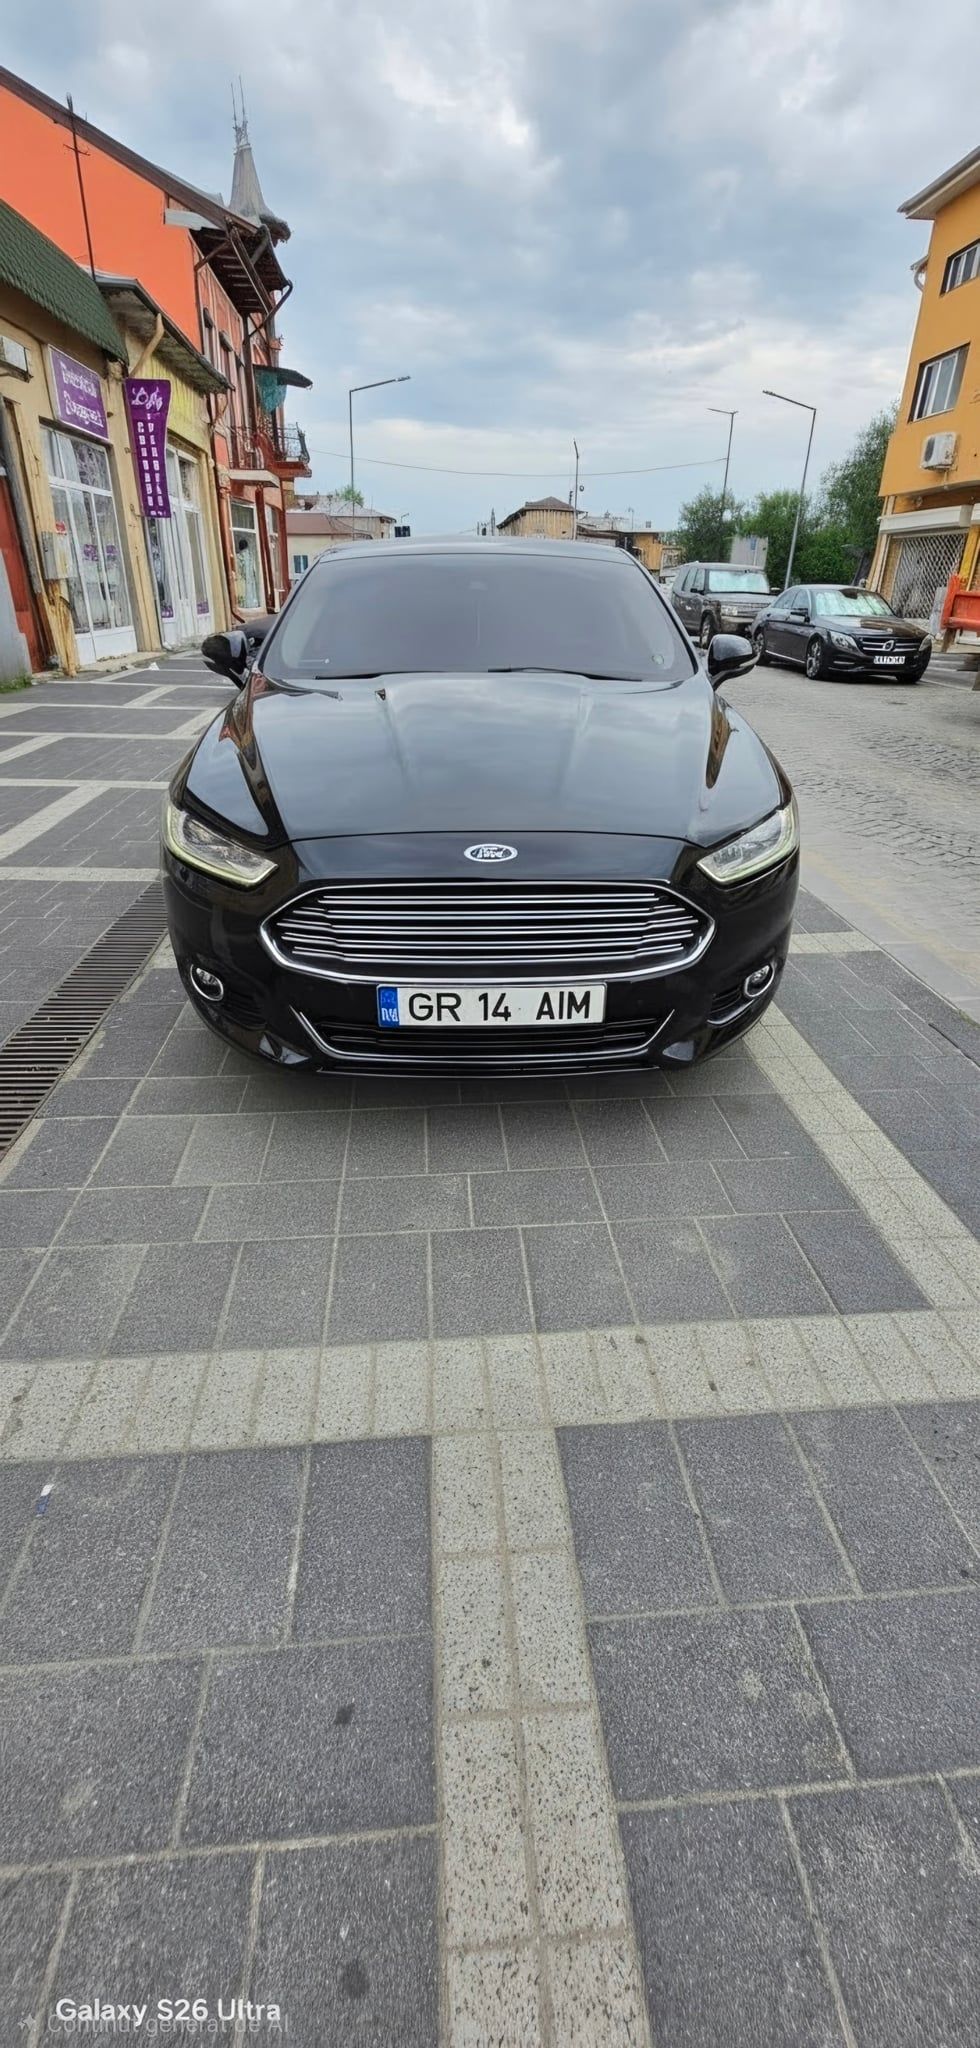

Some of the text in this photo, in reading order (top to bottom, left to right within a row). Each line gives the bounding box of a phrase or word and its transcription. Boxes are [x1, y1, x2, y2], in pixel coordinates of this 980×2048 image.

[408, 992, 462, 1022] GR
[478, 992, 512, 1022] 14
[535, 990, 591, 1020] AIM
